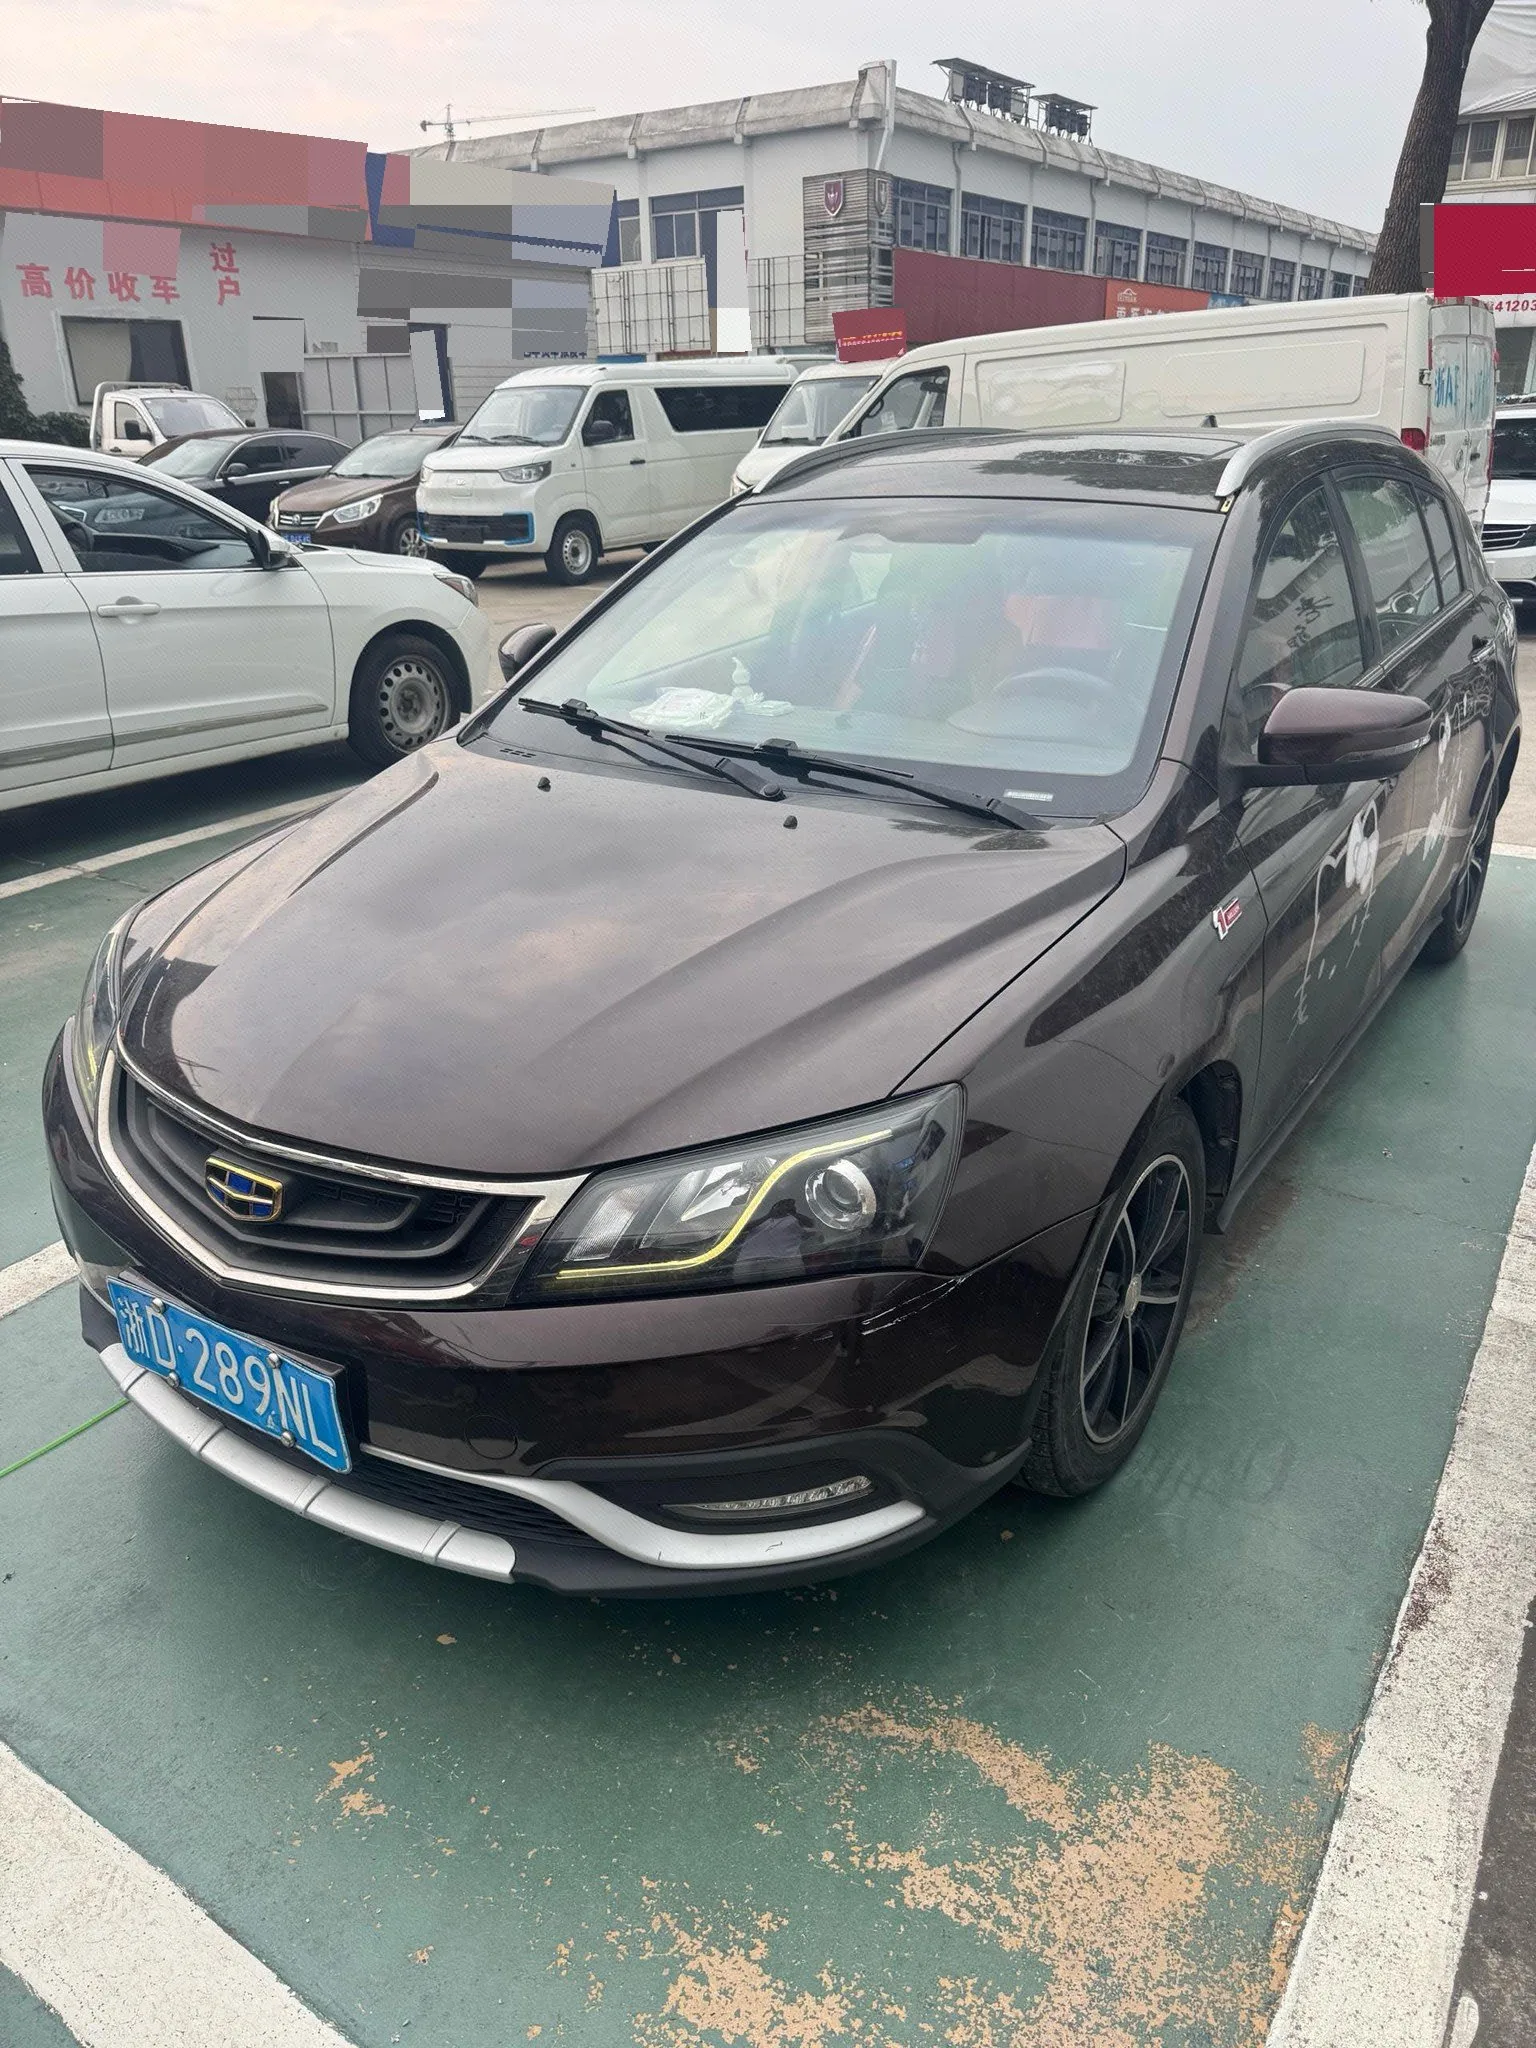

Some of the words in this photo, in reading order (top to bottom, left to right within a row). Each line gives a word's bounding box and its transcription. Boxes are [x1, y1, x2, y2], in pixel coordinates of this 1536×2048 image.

[16, 263, 181, 305] 高价收车
[210, 242, 240, 306] 过户
